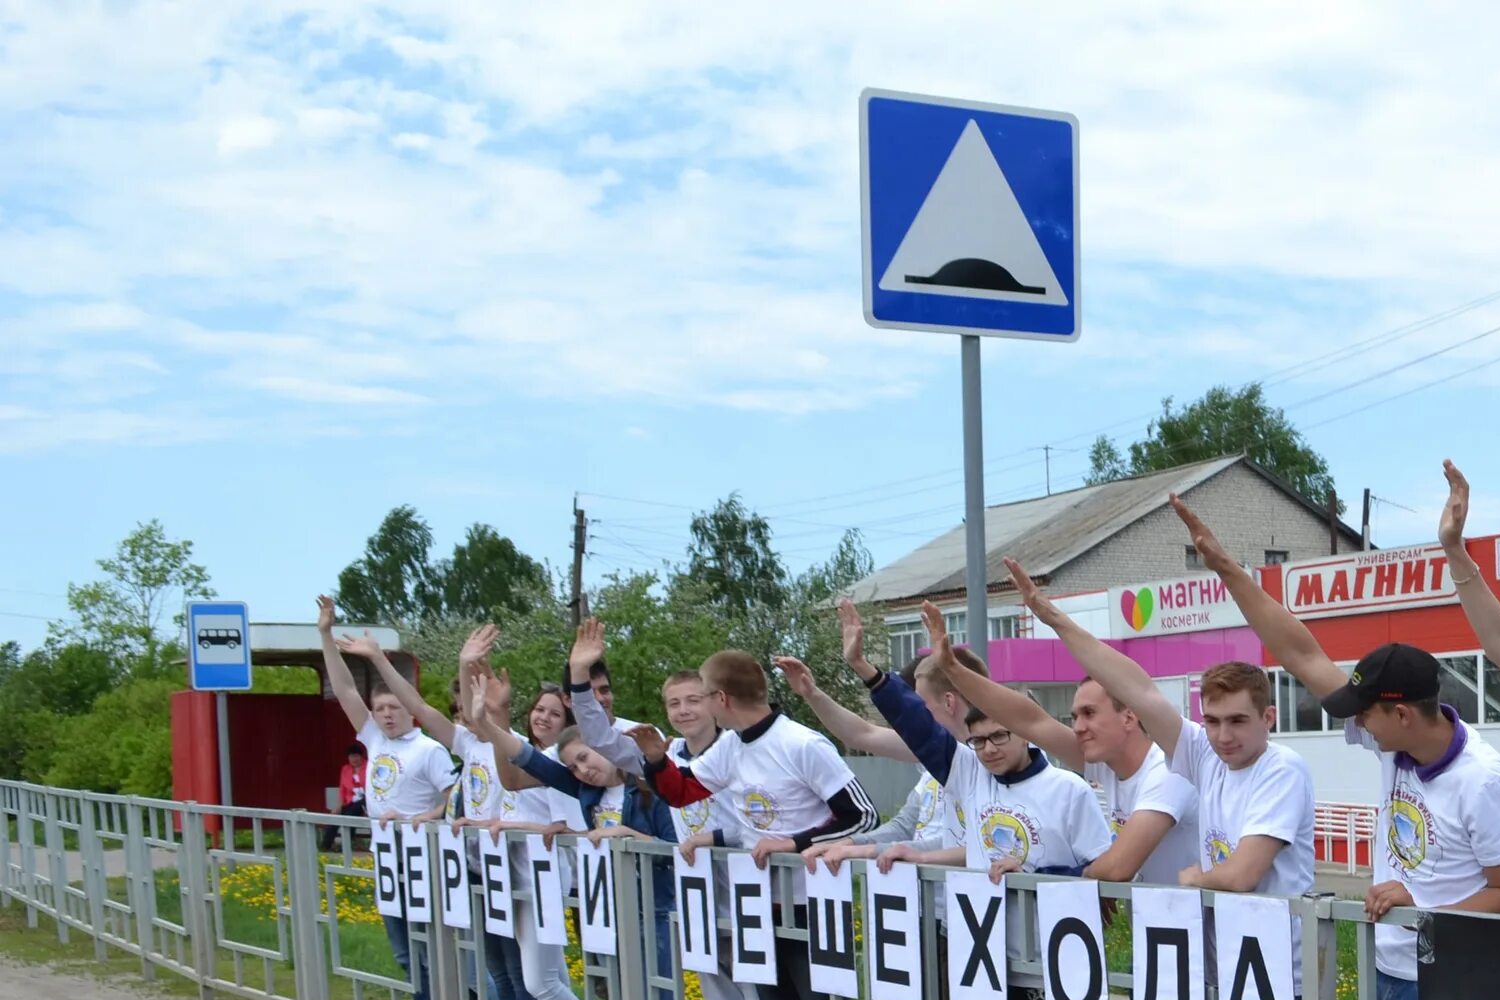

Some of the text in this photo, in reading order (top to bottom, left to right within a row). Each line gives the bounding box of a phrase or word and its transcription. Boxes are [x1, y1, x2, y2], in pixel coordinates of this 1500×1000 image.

[1357, 549, 1422, 565] УНИВЕРСАМ
[1159, 578, 1227, 610] магни
[1295, 557, 1448, 606] МАГНИТ
[1160, 612, 1211, 630] косметик
[376, 843, 610, 928] БЕРЕГИ
